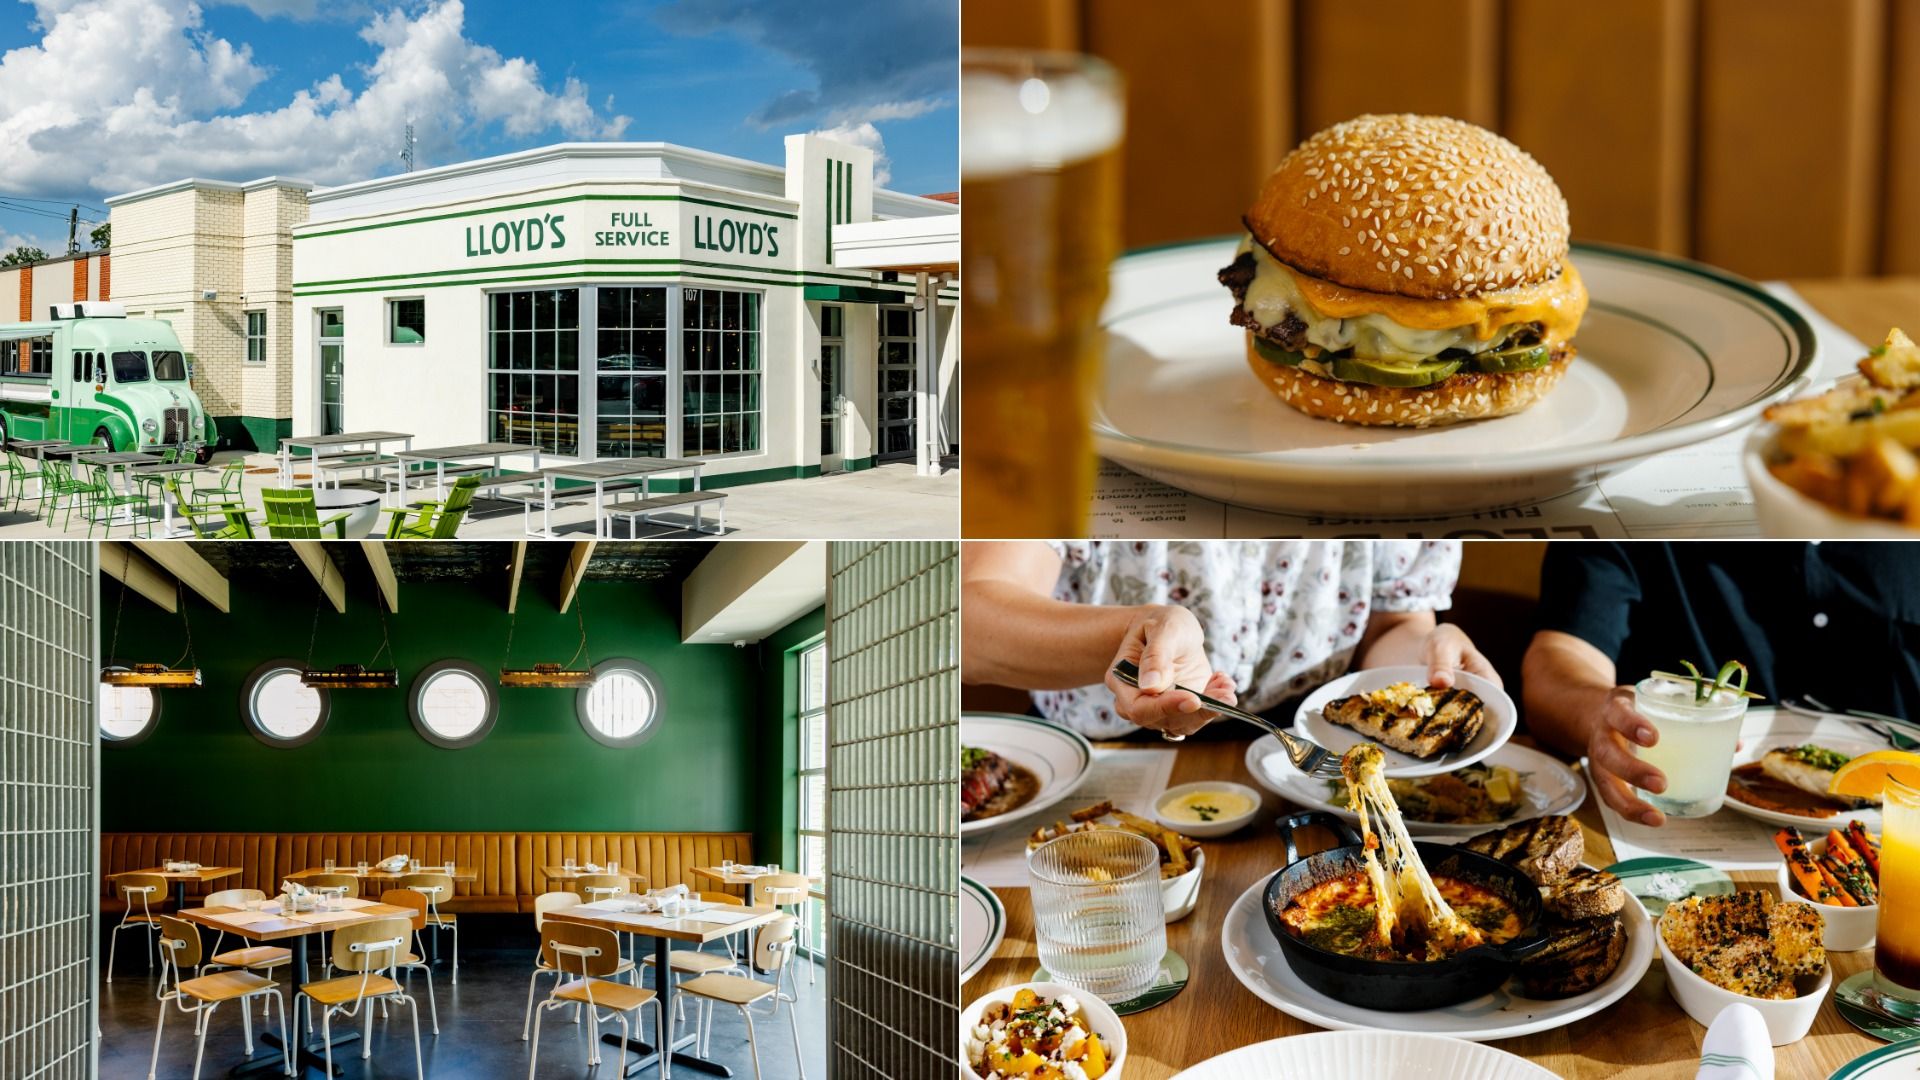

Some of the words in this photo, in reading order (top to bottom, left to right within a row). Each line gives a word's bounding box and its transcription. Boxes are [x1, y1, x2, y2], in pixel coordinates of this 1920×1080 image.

[612, 212, 652, 227] FULL
[467, 213, 565, 257] LLOYD'S
[595, 231, 669, 246] SERVICE
[695, 215, 779, 257] LLOYD'S
[685, 289, 698, 302] 107
